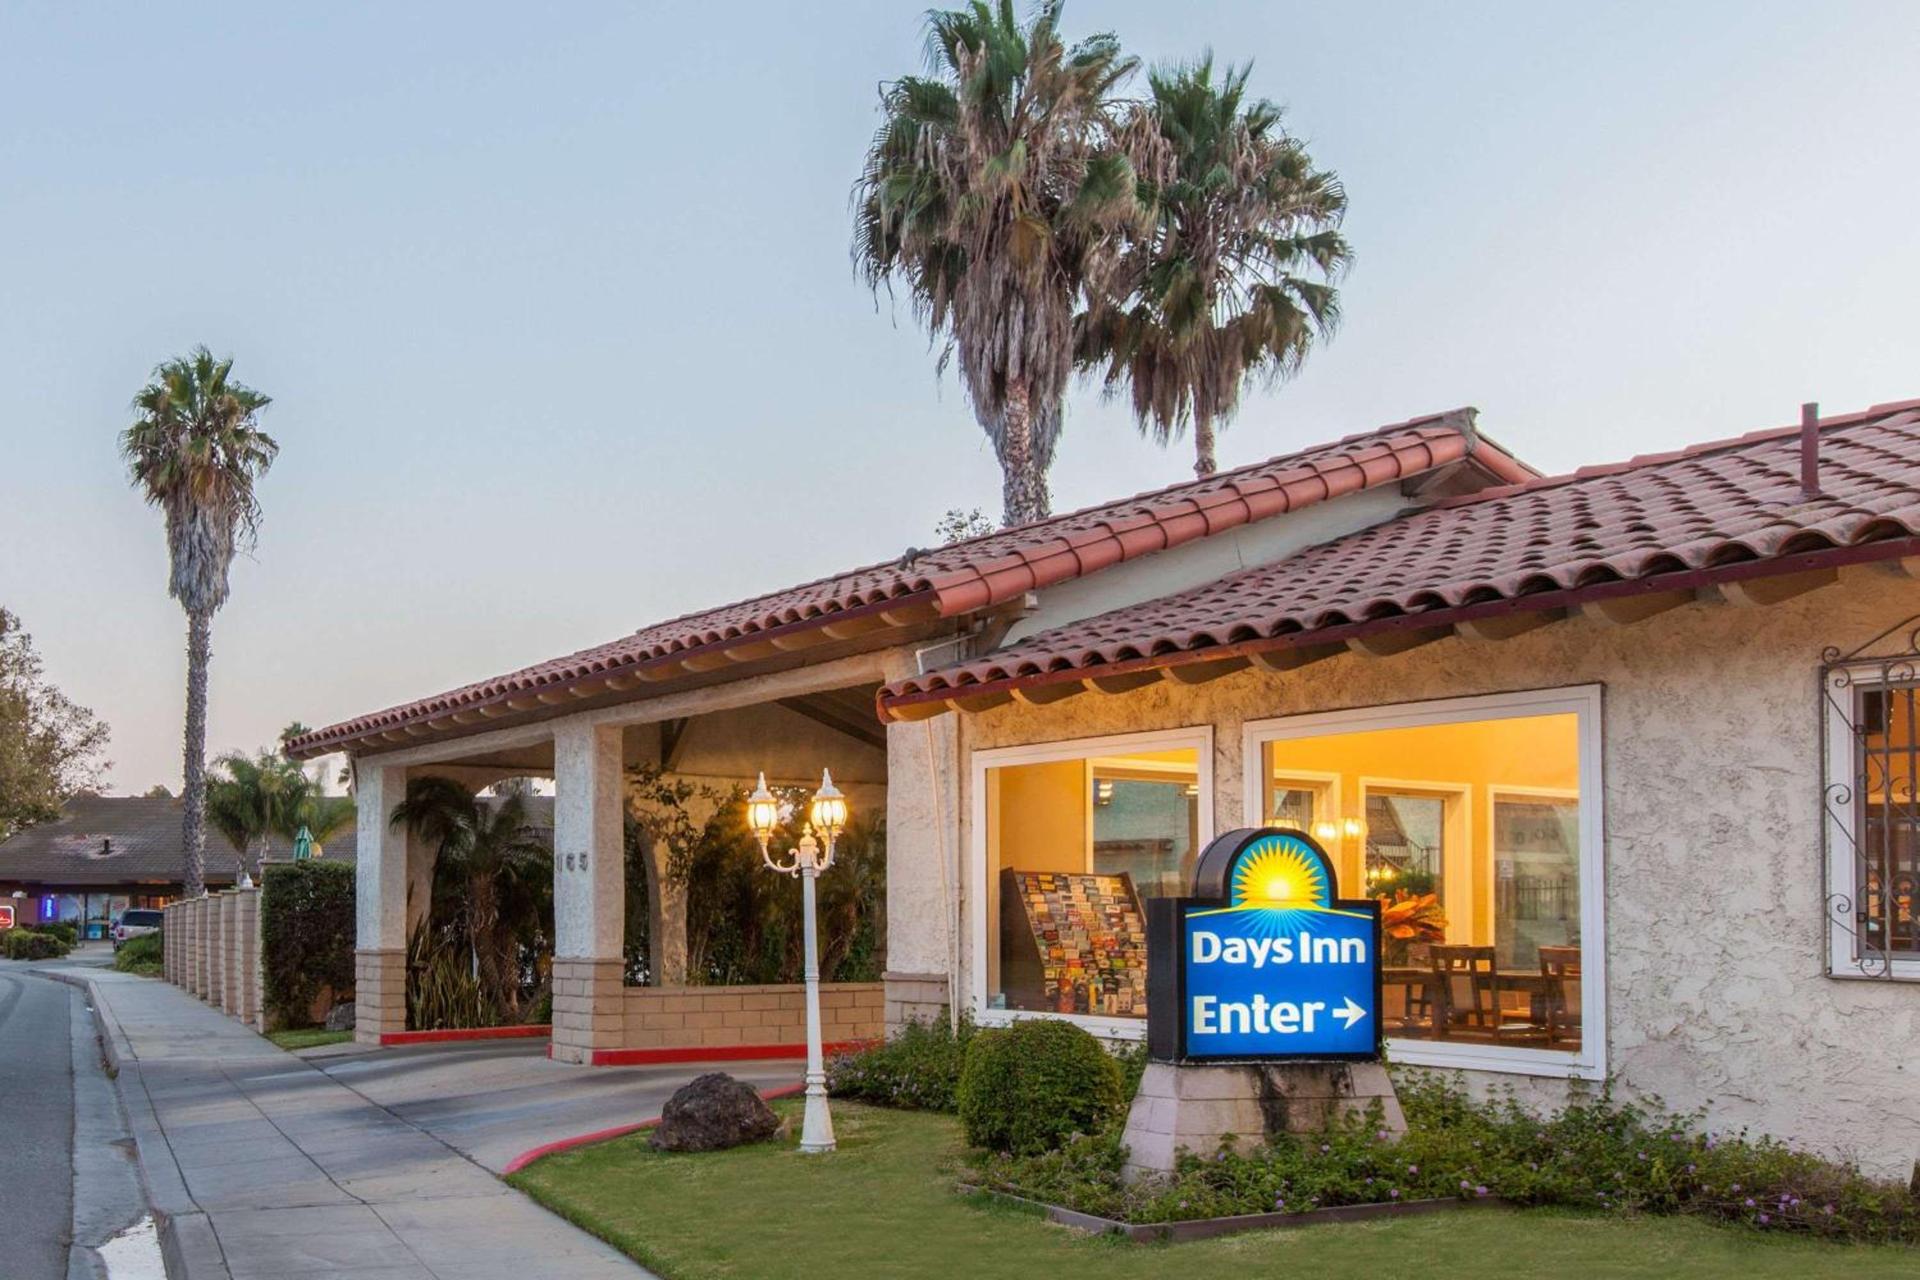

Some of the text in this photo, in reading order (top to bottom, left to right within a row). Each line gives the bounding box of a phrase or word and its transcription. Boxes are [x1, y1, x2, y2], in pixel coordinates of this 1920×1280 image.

[1192, 931, 1366, 969] Days Inn
[1193, 994, 1326, 1034] Enter
